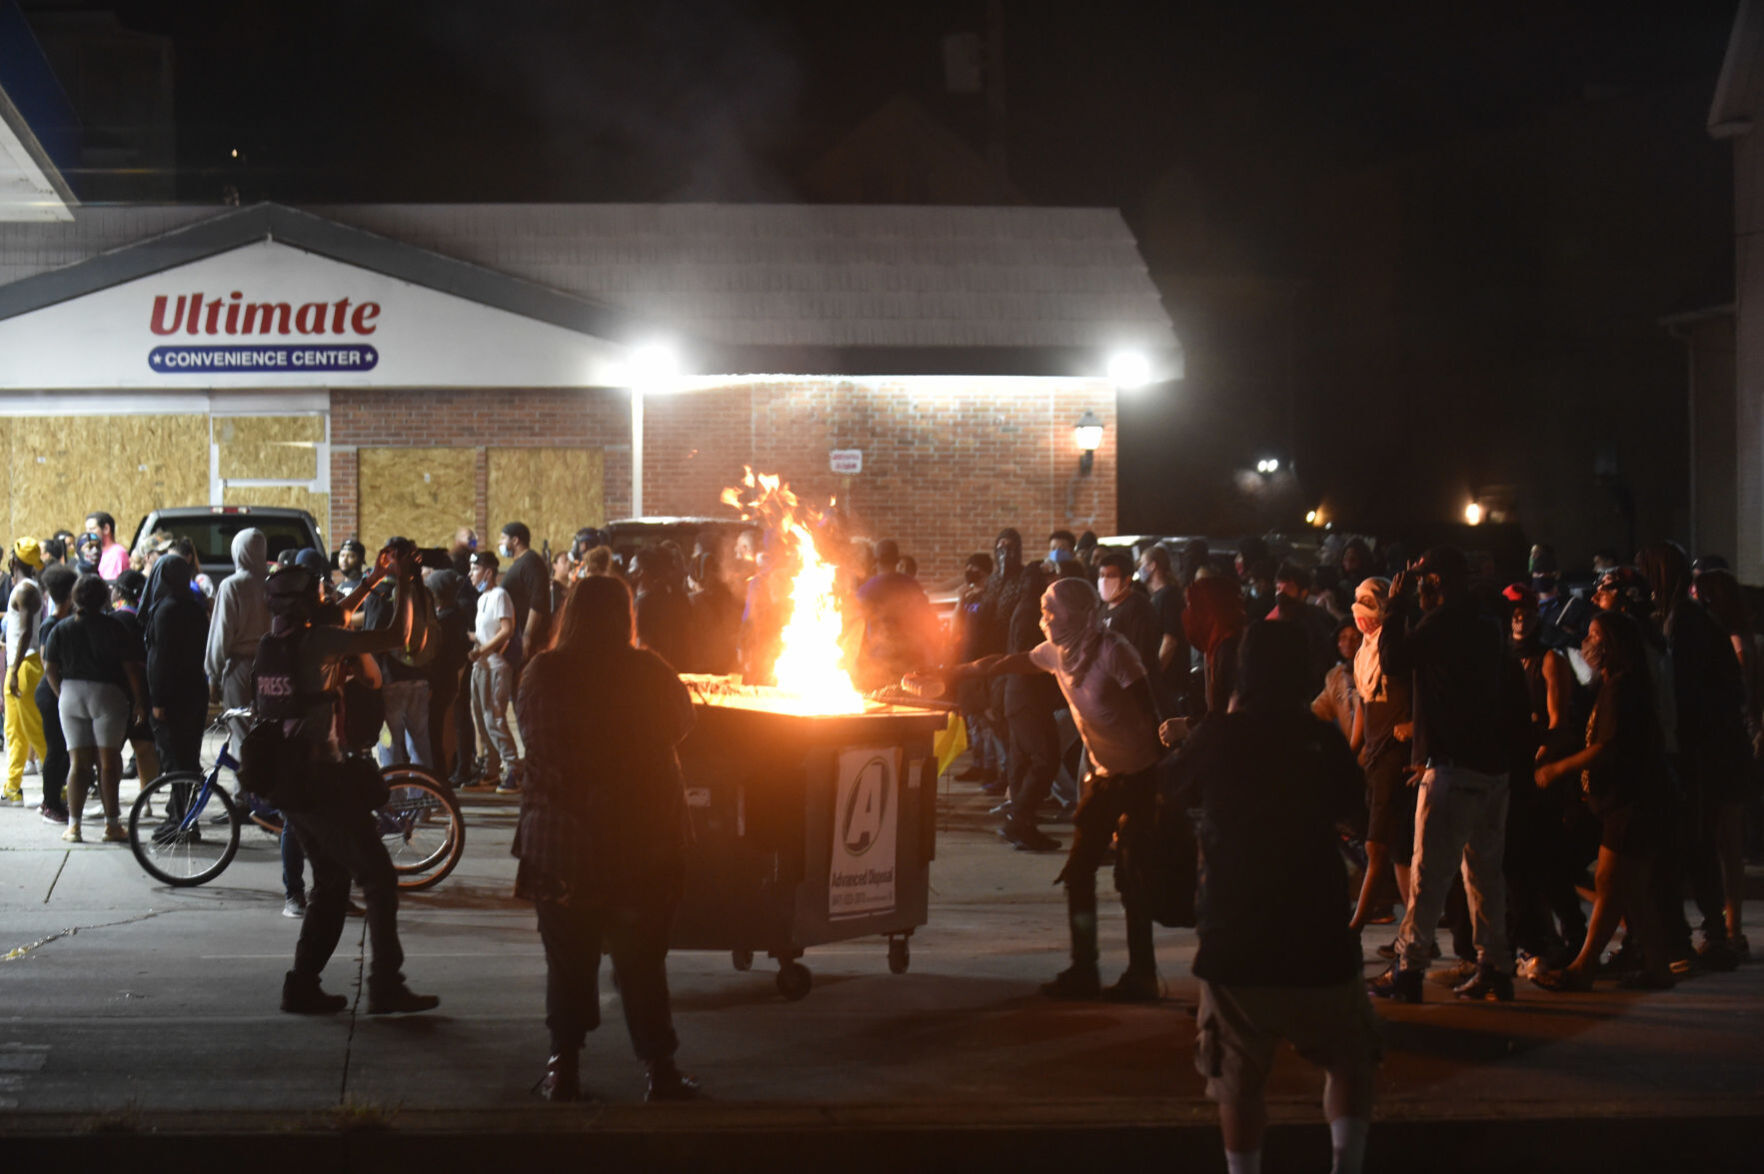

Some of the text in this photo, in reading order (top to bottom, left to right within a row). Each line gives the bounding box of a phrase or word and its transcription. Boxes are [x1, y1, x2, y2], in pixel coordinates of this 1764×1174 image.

[150, 291, 381, 335] Ultimate
[164, 350, 361, 367] CONVENIENCE CENTER
[256, 676, 293, 696] PRESS
